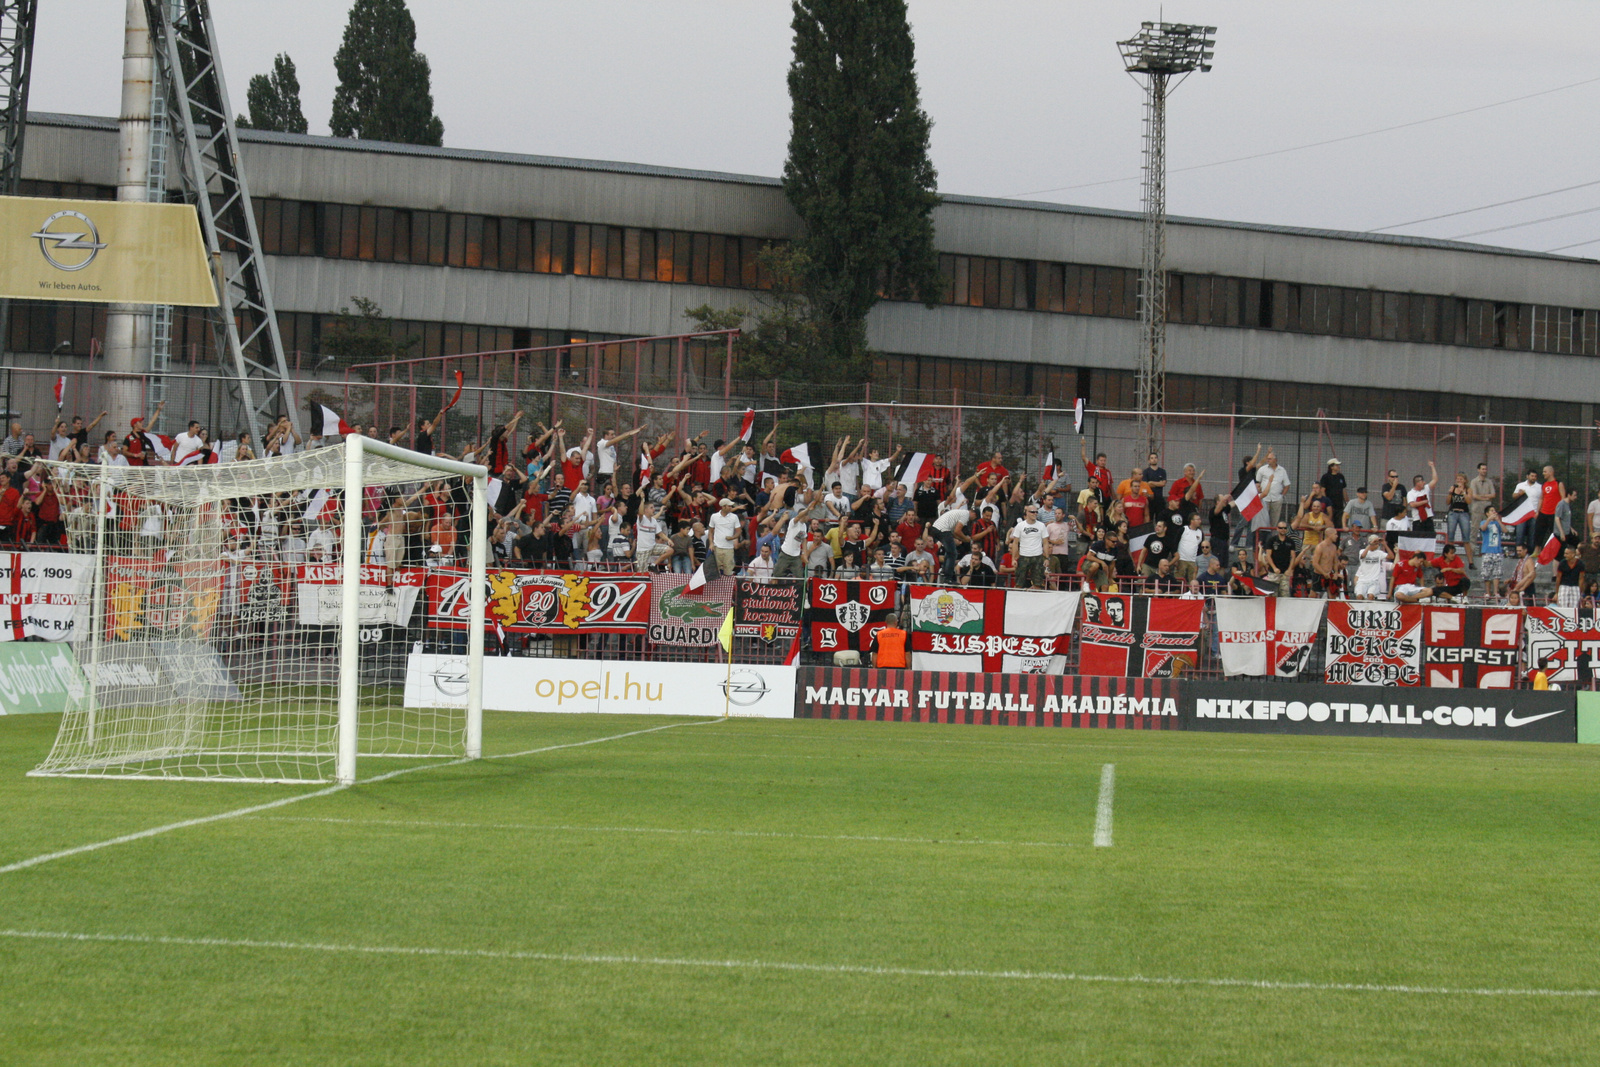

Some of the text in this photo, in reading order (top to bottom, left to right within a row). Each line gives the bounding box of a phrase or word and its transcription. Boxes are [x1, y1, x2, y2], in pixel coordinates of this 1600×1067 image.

[51, 211, 89, 221] OPEL
[39, 281, 102, 291] Wir leben Autos.
[21, 568, 39, 578] AC.
[43, 568, 72, 579] 1909
[305, 565, 386, 583] KISPSTI
[3, 593, 28, 605] NOT
[32, 593, 47, 605] BE
[741, 581, 799, 598] Városok,
[525, 591, 555, 611] 20
[585, 583, 647, 622] 91
[4, 615, 50, 630] FERENC
[1348, 609, 1401, 631] URB
[650, 624, 718, 644] GUARDI
[736, 626, 758, 635] SINCE
[1081, 627, 1136, 645] Lipták
[931, 633, 1057, 657] KISPEST
[1329, 629, 1417, 658] BÉKÉS
[1327, 661, 1418, 687] MEGYE
[535, 671, 662, 705] opel.hu
[805, 686, 1178, 716] MAGYAR FUTBALL AKADÉMIA
